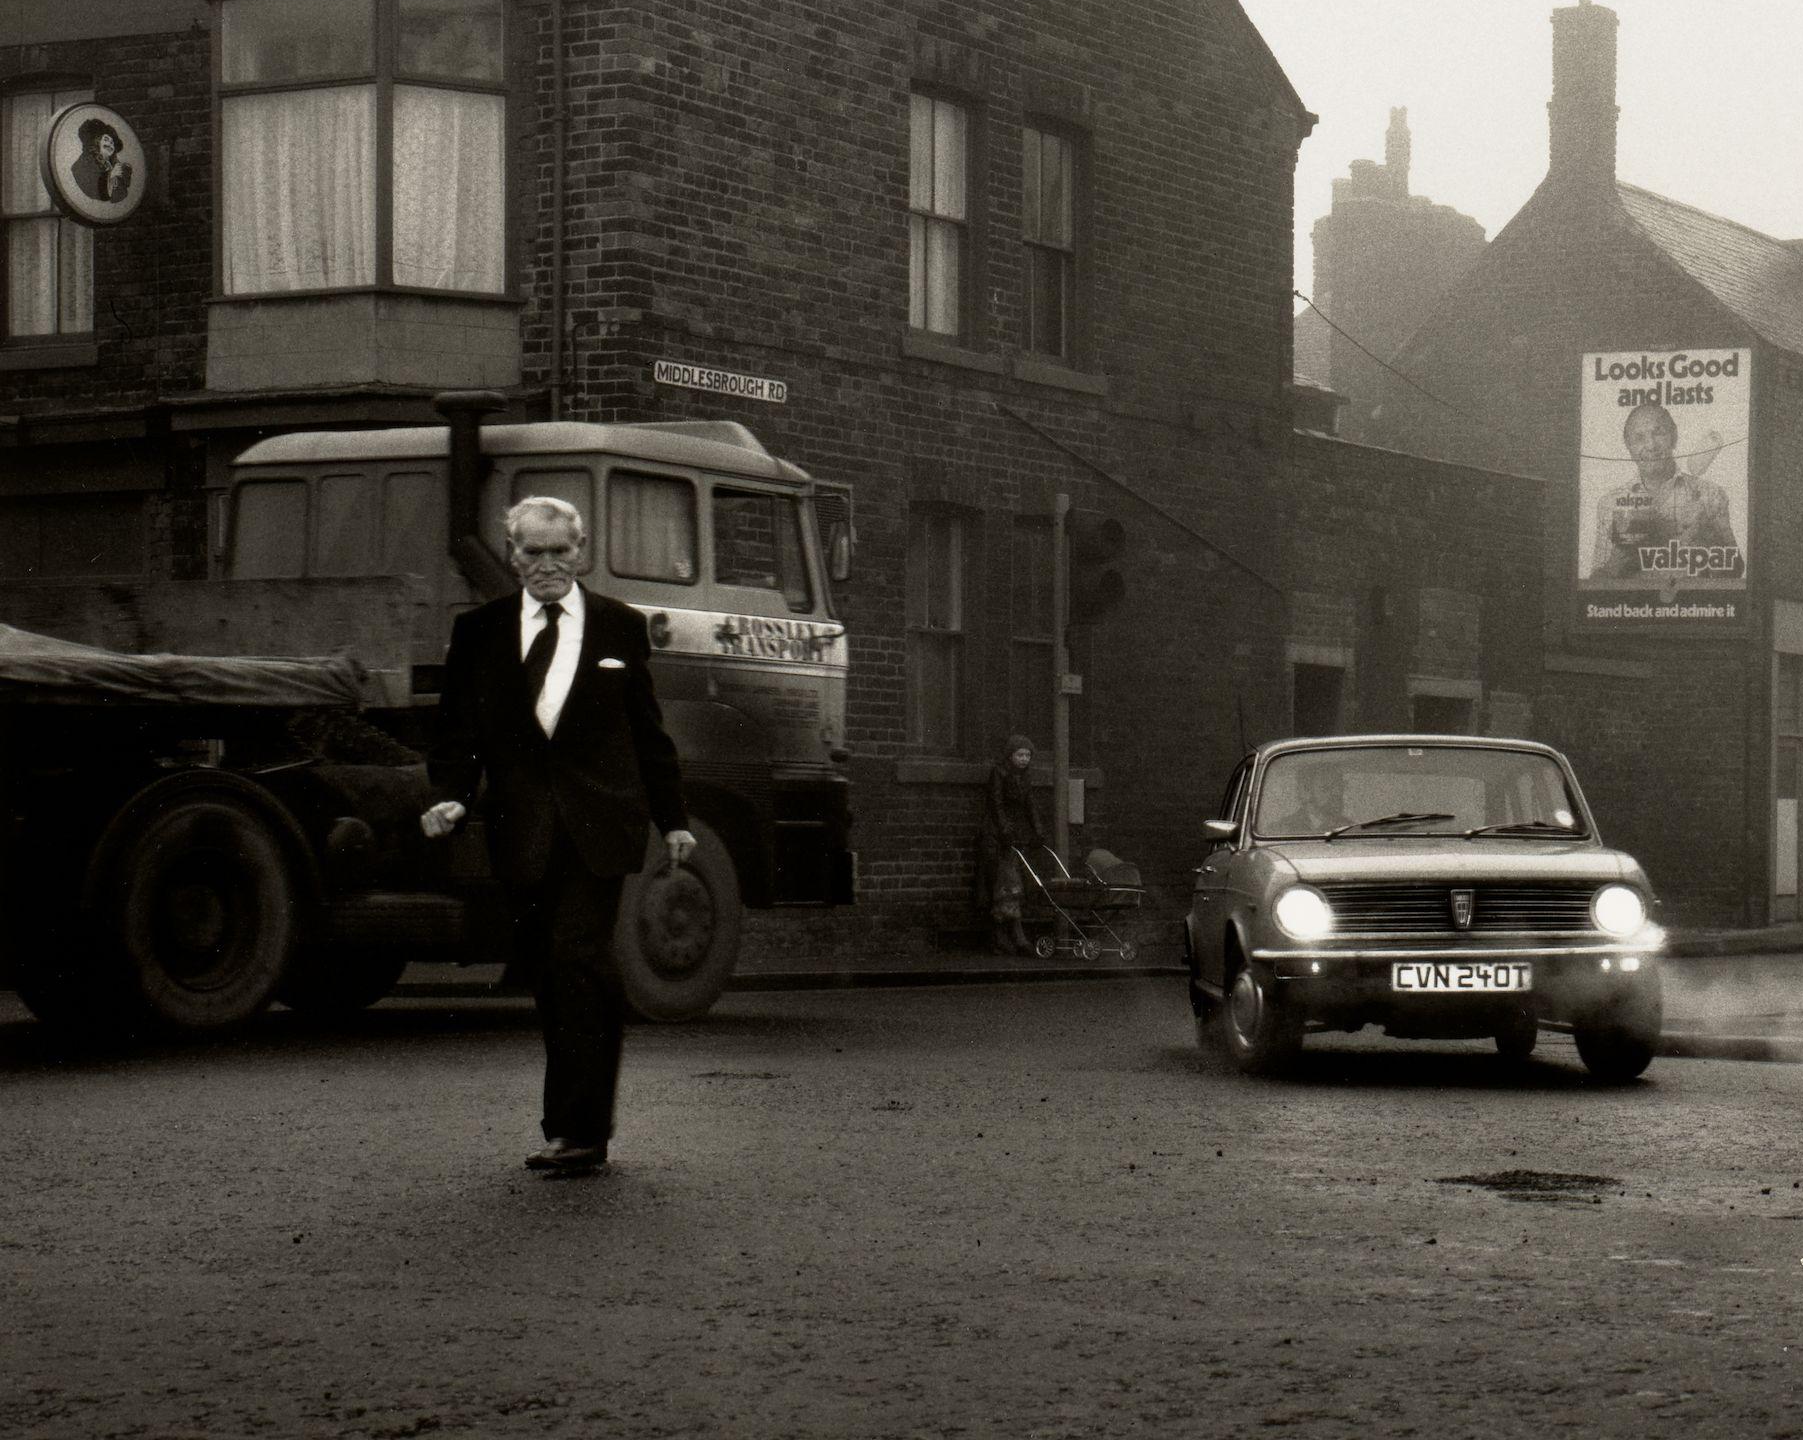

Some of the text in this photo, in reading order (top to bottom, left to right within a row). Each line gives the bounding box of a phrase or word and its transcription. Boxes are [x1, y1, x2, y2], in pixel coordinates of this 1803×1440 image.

[1595, 353, 1739, 381] Looks Good
[657, 363, 785, 400] MIDDLESBROUGH RD
[1618, 381, 1714, 407] and lasts
[1616, 494, 1653, 509] valspar
[1638, 539, 1739, 577] valspar
[1587, 604, 1735, 618] Stand back and admire it
[721, 636, 824, 662] TRANSPORT
[1397, 966, 1529, 988] CVN 240T
